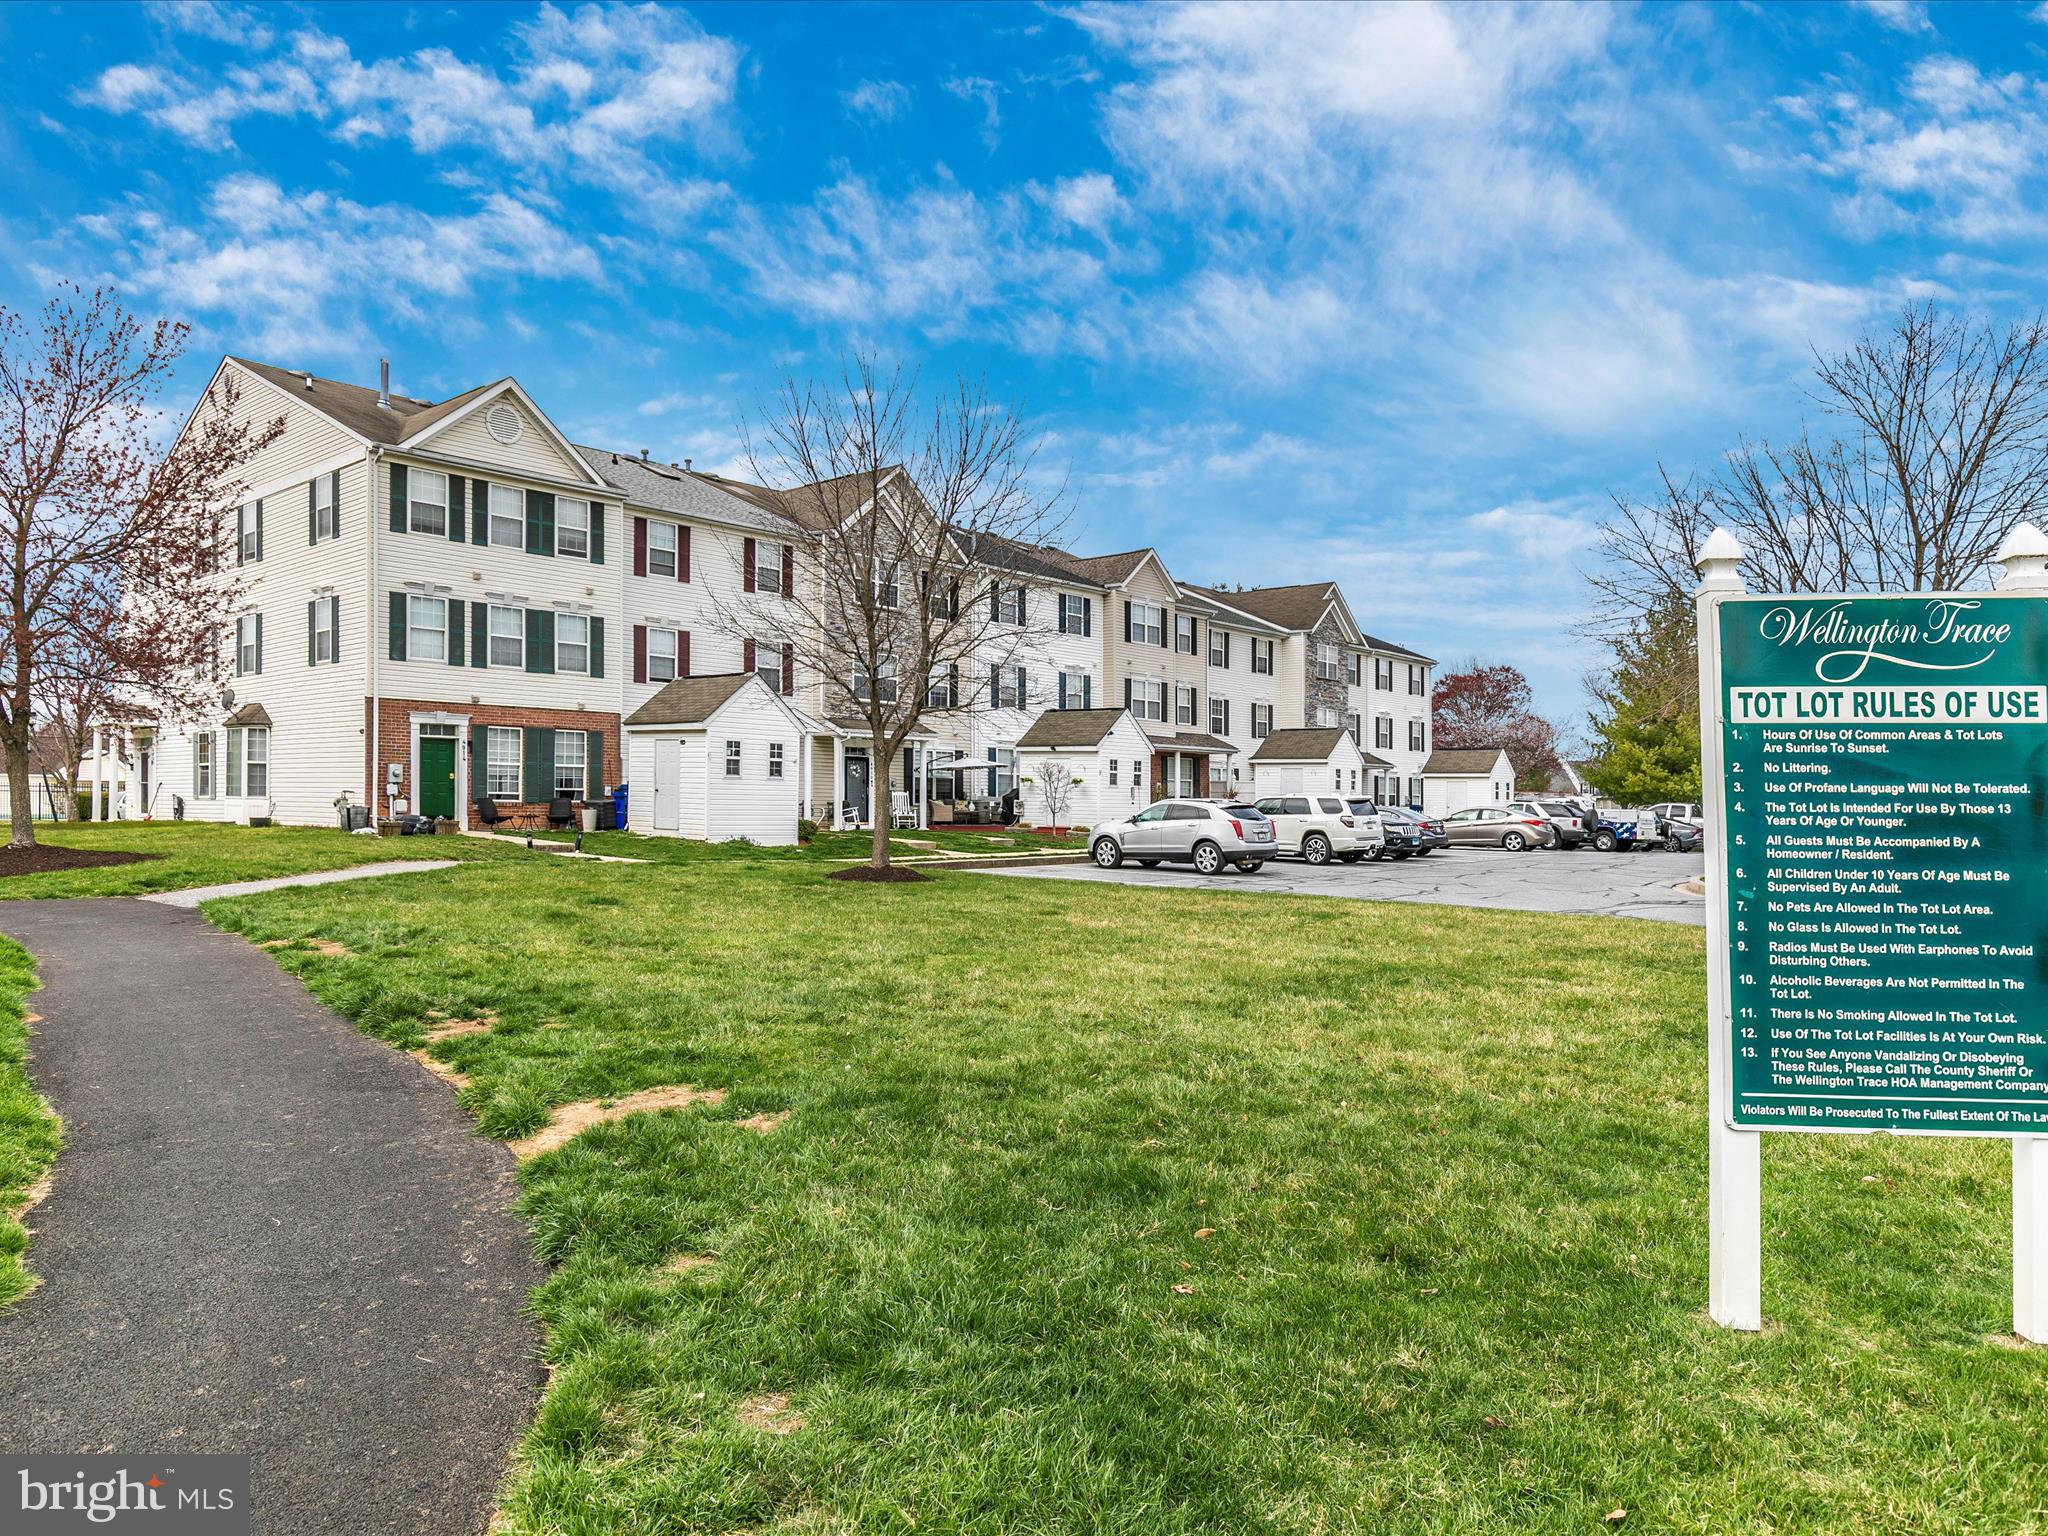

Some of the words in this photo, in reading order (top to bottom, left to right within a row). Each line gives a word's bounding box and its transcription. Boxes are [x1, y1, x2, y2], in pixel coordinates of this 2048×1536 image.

[1759, 601, 1921, 683] Wellington
[1923, 600, 2011, 645] Trace
[1738, 692, 1787, 718] TOT
[1796, 692, 1844, 718] LOT
[1853, 692, 1936, 718] RULES
[1941, 691, 1978, 717] OF
[1988, 691, 2039, 717] USE
[1731, 730, 1743, 740] 1.
[1762, 730, 1797, 740] Hours
[1798, 730, 1813, 740] Of
[1814, 730, 1837, 740] Use
[1838, 730, 1853, 740] Of
[1854, 730, 1906, 740] Common
[1907, 730, 1941, 740] Areas
[1943, 730, 1953, 740] &
[1955, 730, 1975, 740] Tot
[1977, 730, 2004, 740] Lots
[1763, 743, 1783, 753] Are
[1785, 743, 1828, 753] Sunrise
[1830, 743, 1845, 753] To
[1847, 743, 1890, 753] Sunset.
[1732, 763, 1744, 773] 2.
[1763, 763, 1780, 773] No
[1782, 763, 1832, 775] Littering.
[1733, 782, 1745, 792] 3.
[1764, 783, 1786, 793] Use
[1788, 783, 1803, 793] Of
[1804, 783, 1848, 793] Profane
[1850, 783, 1905, 795] Language
[1907, 783, 1929, 793] Will
[1931, 783, 1952, 793] Not
[1954, 783, 1971, 793] Be
[1972, 783, 2031, 793] Tolerated.
[1734, 802, 1745, 812] 4.
[1764, 802, 1786, 812] The
[1788, 803, 1807, 813] Tot
[1809, 803, 1828, 813] Lot
[1830, 803, 1841, 813] Is
[1842, 803, 1892, 813] Intended
[1894, 803, 1914, 813] For
[1915, 804, 1938, 814] Use
[1940, 803, 1957, 815] By
[1958, 804, 1995, 814] Those
[1997, 804, 2012, 814] 13
[1765, 816, 1797, 826] Years
[1799, 816, 1814, 826] Of
[1815, 816, 1838, 828] Age
[1840, 816, 1855, 826] Or
[1856, 816, 1907, 828] Younger.
[1735, 835, 1746, 845] 5.
[1765, 836, 1781, 846] All
[1783, 836, 1824, 846] Guests
[1826, 836, 1854, 846] Must
[1856, 836, 1871, 846] Be
[1873, 837, 1951, 850] Accompanied
[1953, 837, 1969, 849] By
[1971, 837, 1981, 847] A
[1766, 849, 1833, 859] Homeowner
[1835, 849, 1840, 859] /
[1841, 849, 1894, 859] Resident.
[1735, 868, 1747, 878] 6.
[1766, 869, 1782, 879] All
[1784, 869, 1832, 879] Children
[1834, 870, 1869, 880] Under
[1871, 870, 1885, 880] 10
[1886, 870, 1919, 880] Years
[1921, 870, 1936, 880] Of
[1937, 871, 1961, 882] Age
[1963, 871, 1992, 881] Must
[1994, 871, 2010, 881] Be
[1767, 882, 1830, 893] Supervised
[1832, 883, 1848, 894] By
[1850, 883, 1866, 893] An
[1868, 883, 1902, 893] Adult.
[1736, 901, 1748, 911] 7.
[1768, 902, 1784, 912] No
[1786, 902, 1811, 912] Pets
[1813, 903, 1834, 913] Are
[1835, 903, 1881, 913] Allowed
[1883, 903, 1894, 913] In
[1896, 903, 1918, 913] The
[1920, 904, 1940, 914] Tot
[1941, 904, 1961, 914] Lot
[1963, 904, 1994, 914] Area.
[1737, 921, 1748, 931] 8.
[1768, 922, 1785, 932] No
[1786, 922, 1819, 932] Glass
[1821, 923, 1832, 933] Is
[1833, 923, 1879, 933] Allowed
[1881, 924, 1892, 934] In
[1894, 924, 1916, 934] The
[1918, 924, 1938, 934] Tot
[1940, 925, 1962, 935] Lot.
[1737, 941, 1749, 951] 9.
[1768, 942, 1808, 952] Radios
[1810, 943, 1838, 953] Must
[1840, 943, 1856, 953] Be
[1858, 944, 1887, 954] Used
[1889, 944, 1916, 954] With
[1918, 944, 1980, 956] Earphones
[1981, 945, 1998, 955] To
[1999, 946, 2034, 956] Avoid
[1769, 955, 1827, 968] Disturbing
[1829, 956, 1871, 966] Others.
[1739, 975, 1757, 985] 10.
[1769, 975, 1822, 985] Alcoholic
[1824, 976, 1883, 989] Beverages
[1885, 977, 1906, 987] Are
[1908, 978, 1929, 988] Not
[1931, 978, 1986, 988] Permitted
[1988, 979, 2000, 989] In
[2002, 979, 2025, 989] The
[1769, 988, 1788, 998] Tot
[1790, 989, 1812, 999] Lot.
[1740, 1008, 1757, 1018] 11.
[1770, 1008, 1802, 1018] There
[1804, 1009, 1815, 1019] Is
[1817, 1010, 1834, 1020] No
[1835, 1010, 1885, 1022] Smoking
[1887, 1011, 1933, 1021] Allowed
[1935, 1012, 1947, 1022] In
[1948, 1012, 1971, 1022] The
[1973, 1012, 1993, 1022] Tot
[1995, 1013, 2018, 1023] Lot.
[1740, 1047, 1758, 1057] 13.
[1771, 1048, 1779, 1058] If
[1781, 1048, 1803, 1058] You
[1805, 1049, 1827, 1059] See
[1829, 1049, 1872, 1062] Anyone
[1874, 1050, 1940, 1063] Vandalizing
[1942, 1052, 1957, 1062] Or
[1959, 1052, 2025, 1065] Disobeying
[1770, 1061, 1805, 1072] These
[1807, 1062, 1843, 1074] Rules,
[1845, 1063, 1883, 1073] Please
[1885, 1064, 1907, 1074] Call
[1909, 1064, 1931, 1074] The
[1933, 1065, 1975, 1077] County
[1977, 1066, 2017, 1076] Sheriff
[2018, 1067, 2034, 1076] Or
[1771, 1074, 1793, 1084] The
[1794, 1075, 1854, 1087] Wellington
[1856, 1077, 1889, 1087] Trace
[1891, 1077, 1918, 1087] HOA
[1920, 1077, 1993, 1091] Management
